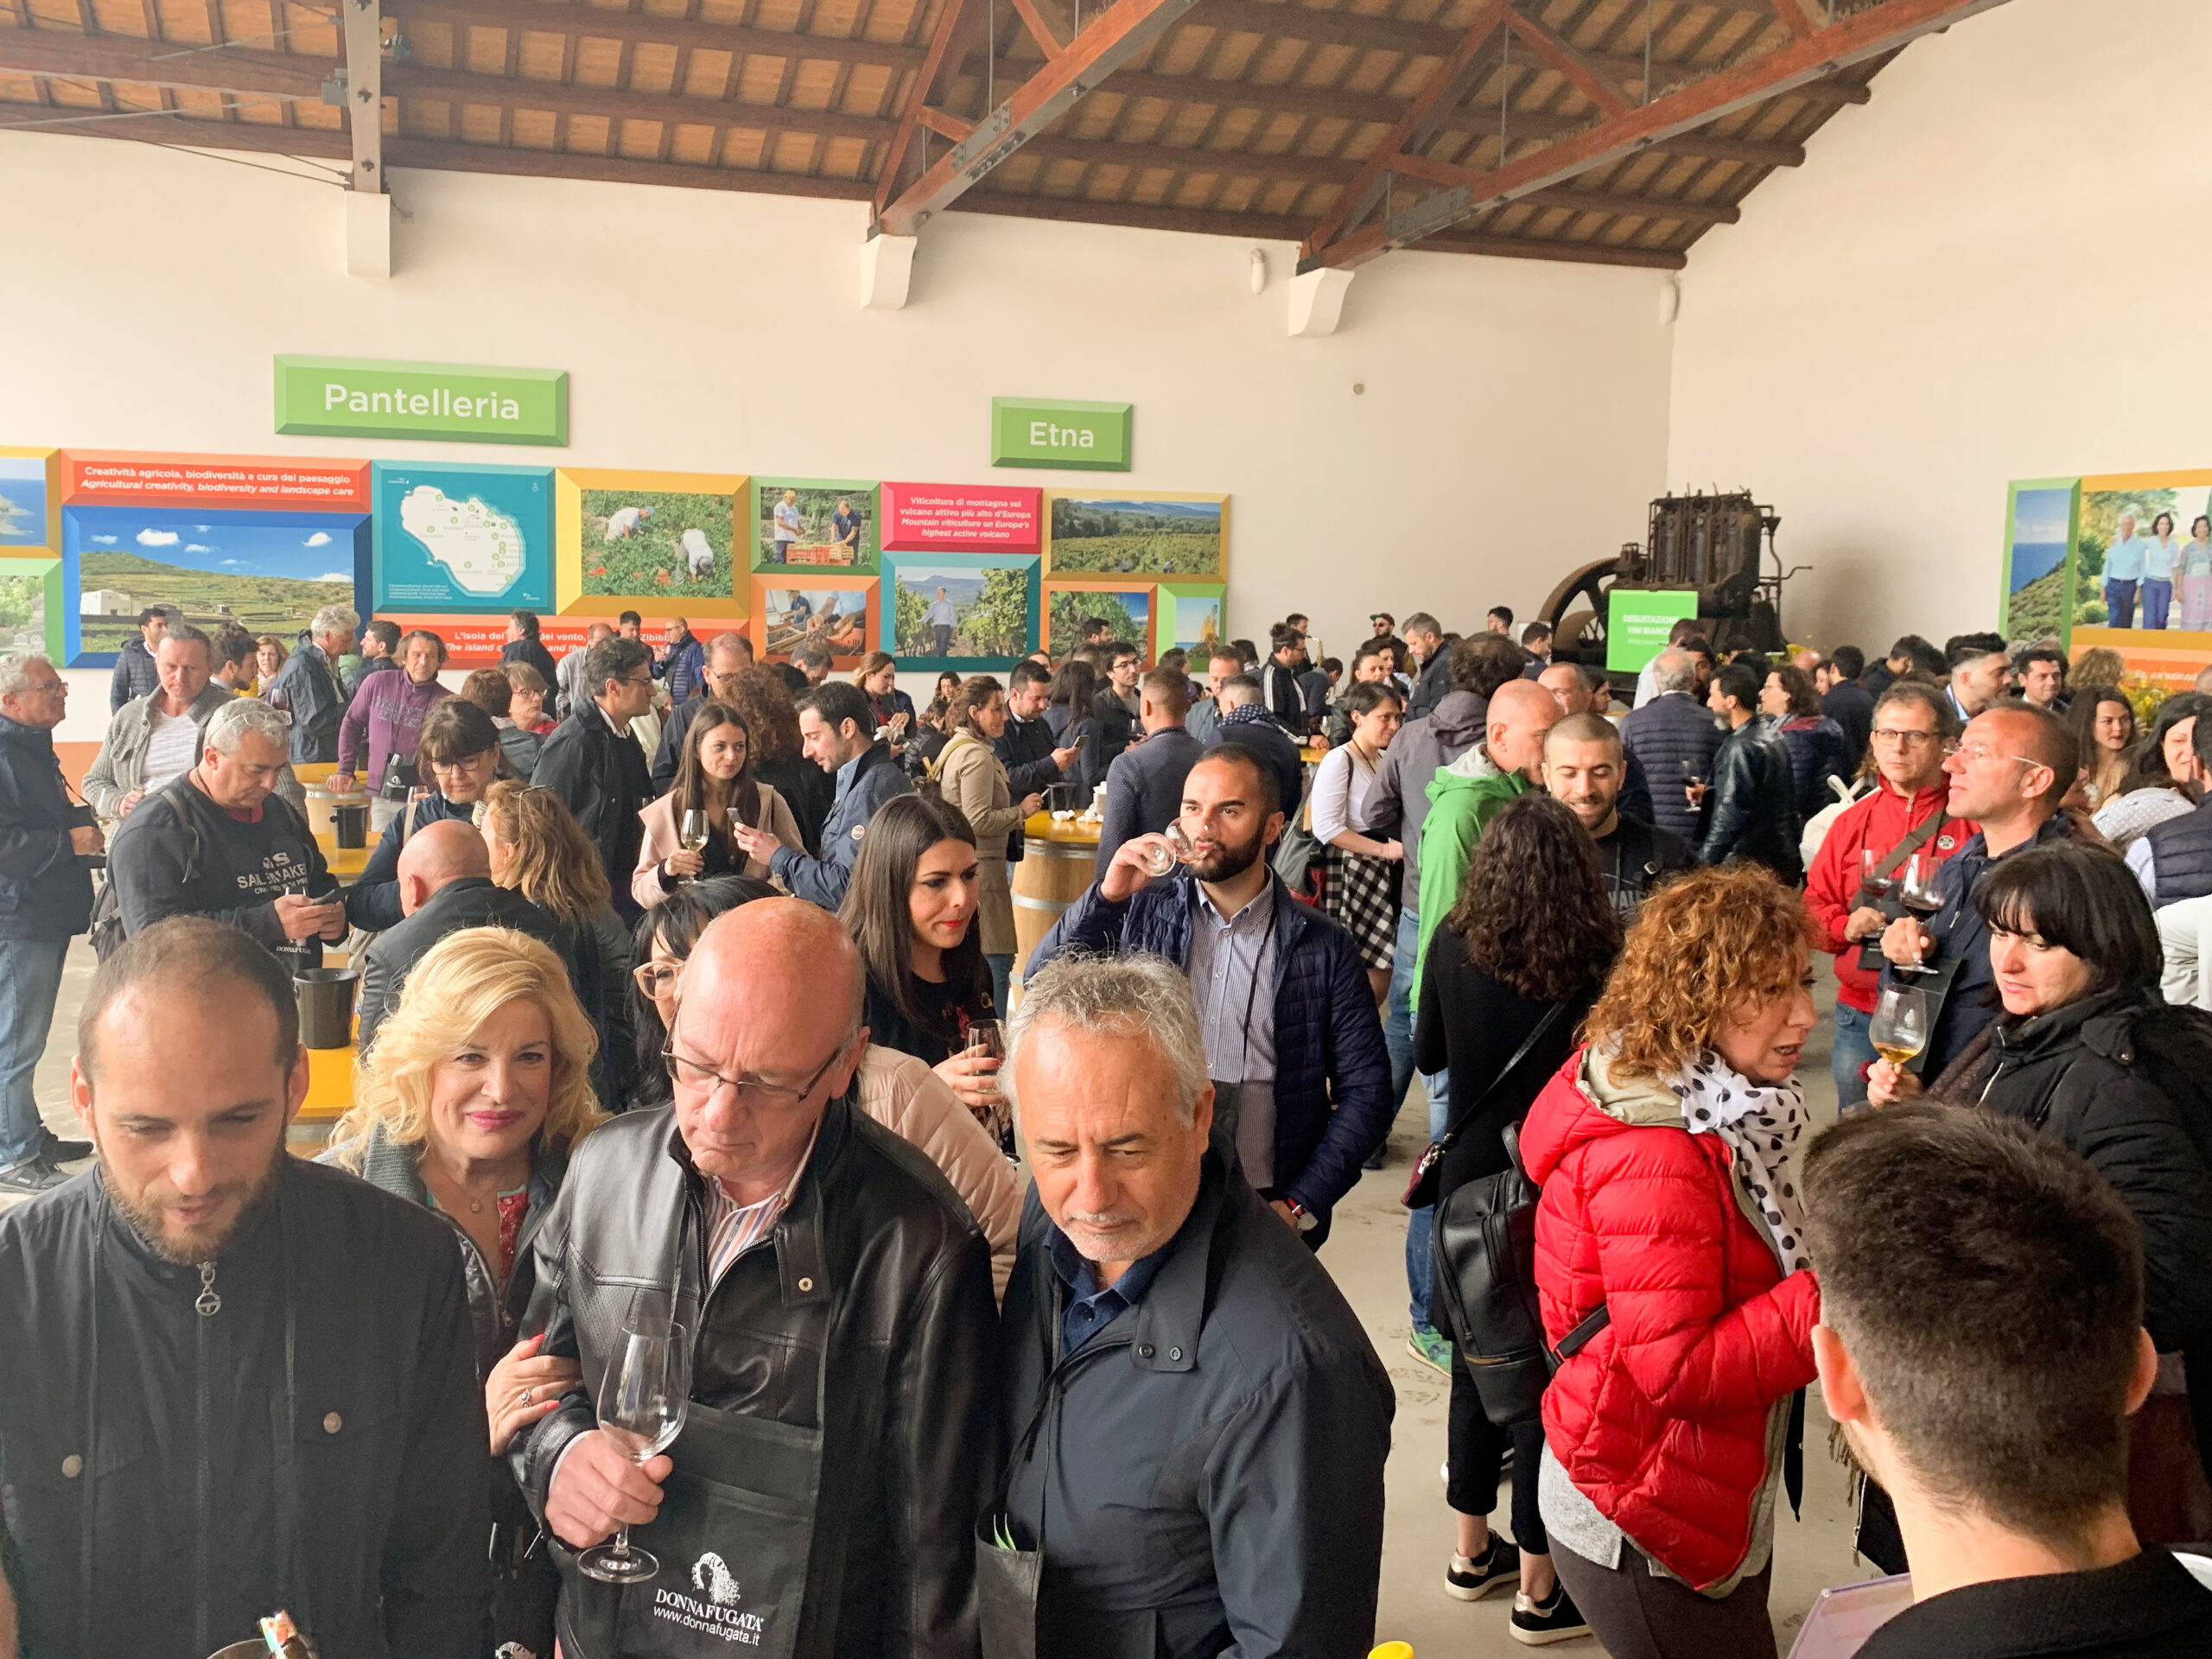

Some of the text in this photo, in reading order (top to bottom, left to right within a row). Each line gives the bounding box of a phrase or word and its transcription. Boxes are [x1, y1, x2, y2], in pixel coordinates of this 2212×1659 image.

[325, 383, 519, 420] Pantelleria
[1030, 421, 1094, 448] Etna
[85, 467, 136, 477] Creatività
[138, 468, 183, 479] agricola,
[186, 470, 245, 480] biodiversità
[298, 474, 350, 485] paesaggio
[80, 479, 143, 489] Agricultural
[145, 481, 194, 492] creativity,
[198, 482, 257, 494] biodiversity
[281, 486, 330, 496] landscape
[910, 497, 954, 505] Viticoltura
[966, 499, 1008, 508] montagna
[961, 509, 975, 518] più
[995, 510, 1032, 519] d'Europa
[901, 518, 939, 526] Mountain
[941, 518, 982, 527] viticulture
[995, 520, 1029, 530] Europe's
[921, 528, 1010, 538] highest active volcano
[454, 631, 486, 640] L'isola
[556, 633, 587, 642] vento,
[464, 643, 494, 652] island
[655, 1588, 762, 1631] DONNAFUGATA
[653, 1605, 760, 1646] www.donnafugata.it
